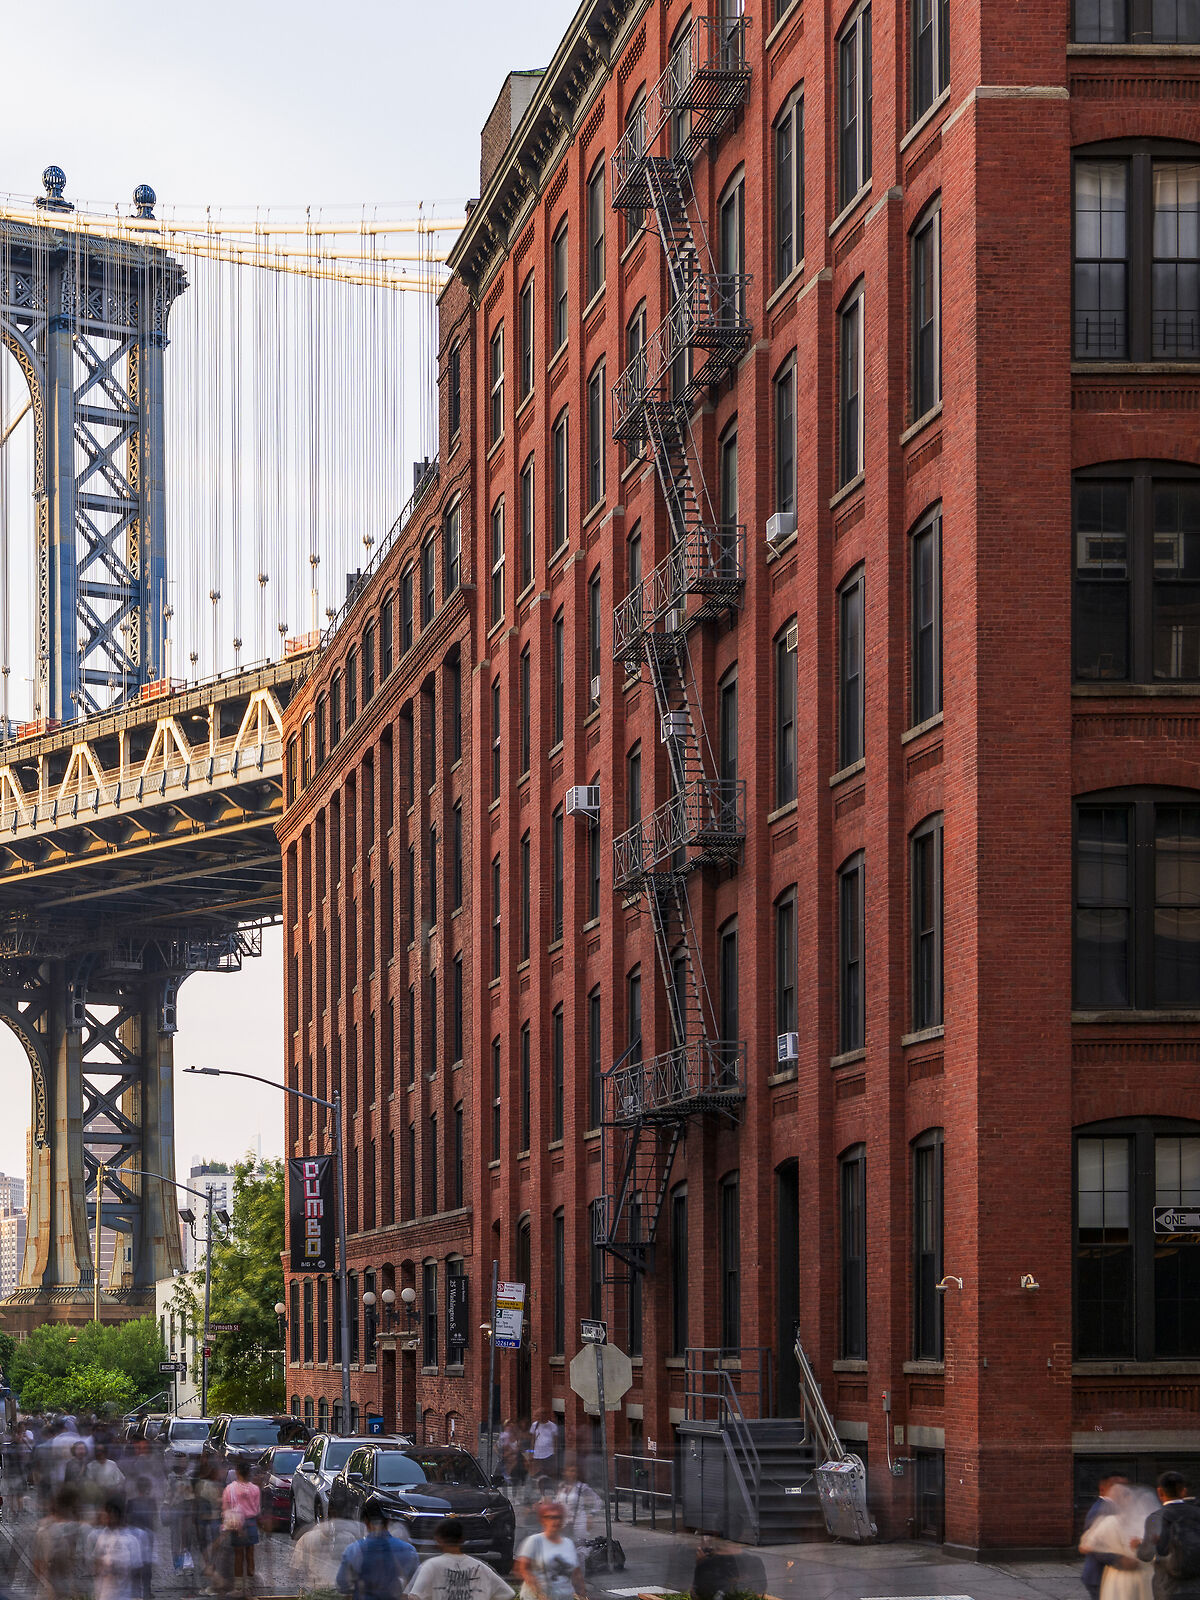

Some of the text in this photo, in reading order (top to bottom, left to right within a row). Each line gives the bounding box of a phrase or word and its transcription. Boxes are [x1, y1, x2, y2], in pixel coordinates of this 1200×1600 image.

[303, 1161, 324, 1258] DUMBO
[1164, 1214, 1187, 1225] ONE
[448, 1288, 456, 1322] Washington
[373, 1424, 380, 1432] P
